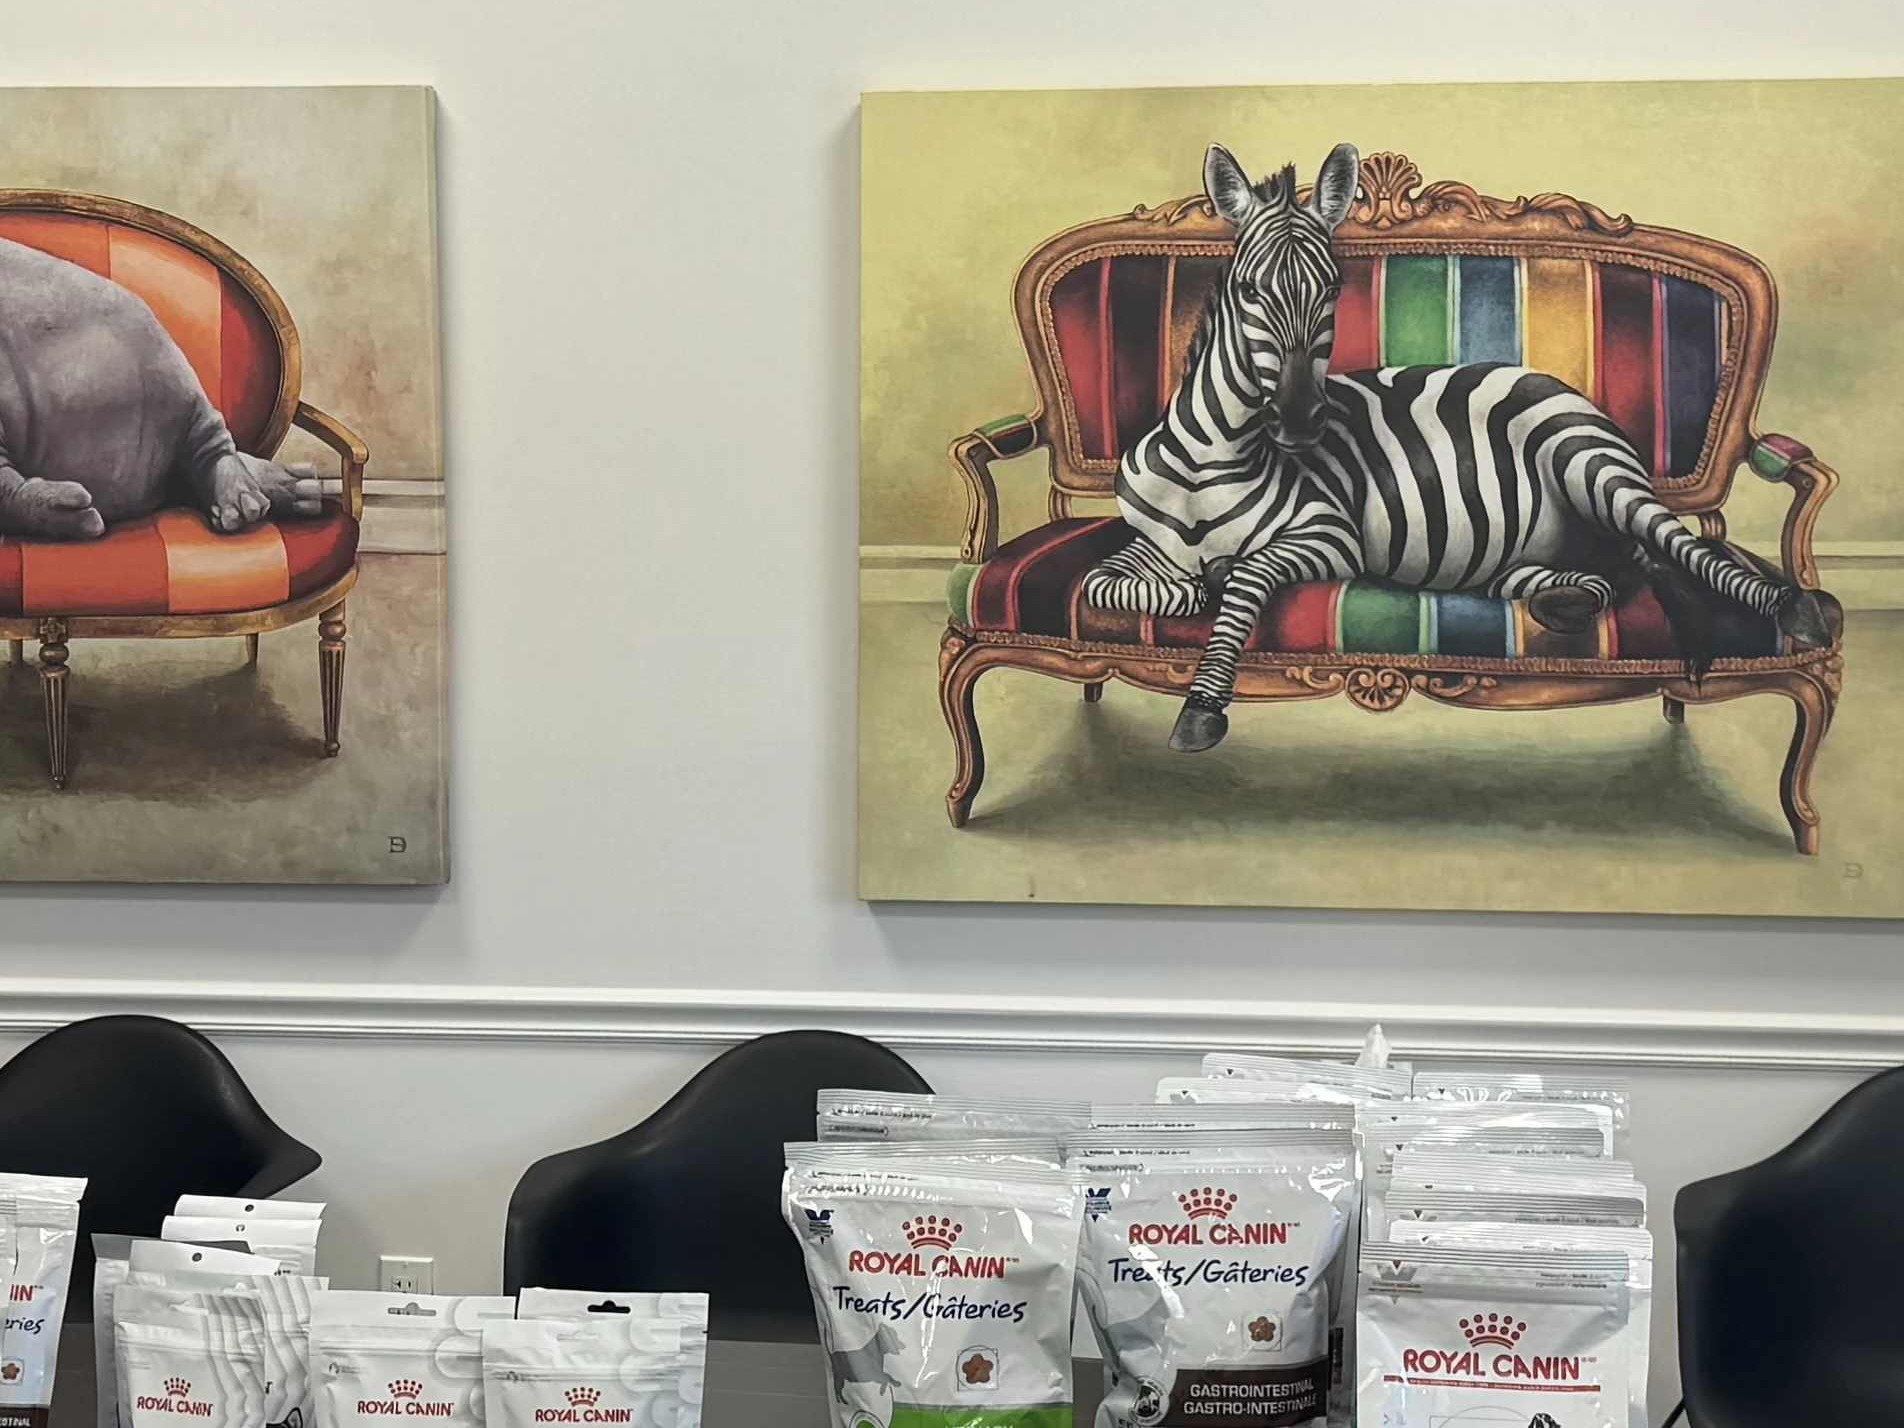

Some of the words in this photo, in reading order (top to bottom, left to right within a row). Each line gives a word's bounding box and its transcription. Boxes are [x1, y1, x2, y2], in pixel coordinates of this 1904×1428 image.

[1128, 1222, 1204, 1245] ROYAL
[1208, 1222, 1287, 1246] CANIN
[848, 1249, 926, 1276] ROYAL
[931, 1254, 1005, 1279] CANIN
[1402, 1348, 1487, 1377] ROYAL
[1492, 1354, 1580, 1380] CANIN
[1190, 1377, 1315, 1398] GASTROINTESTINAL
[136, 1396, 174, 1413] ROYAL
[176, 1401, 213, 1417] CANIN
[357, 1400, 402, 1415] ROYAL
[405, 1402, 453, 1417] CANIN
[535, 1408, 580, 1423] ROYAL
[583, 1408, 632, 1423] CANIN
[1183, 1393, 1317, 1416] GASTRO-INTESTINALE
